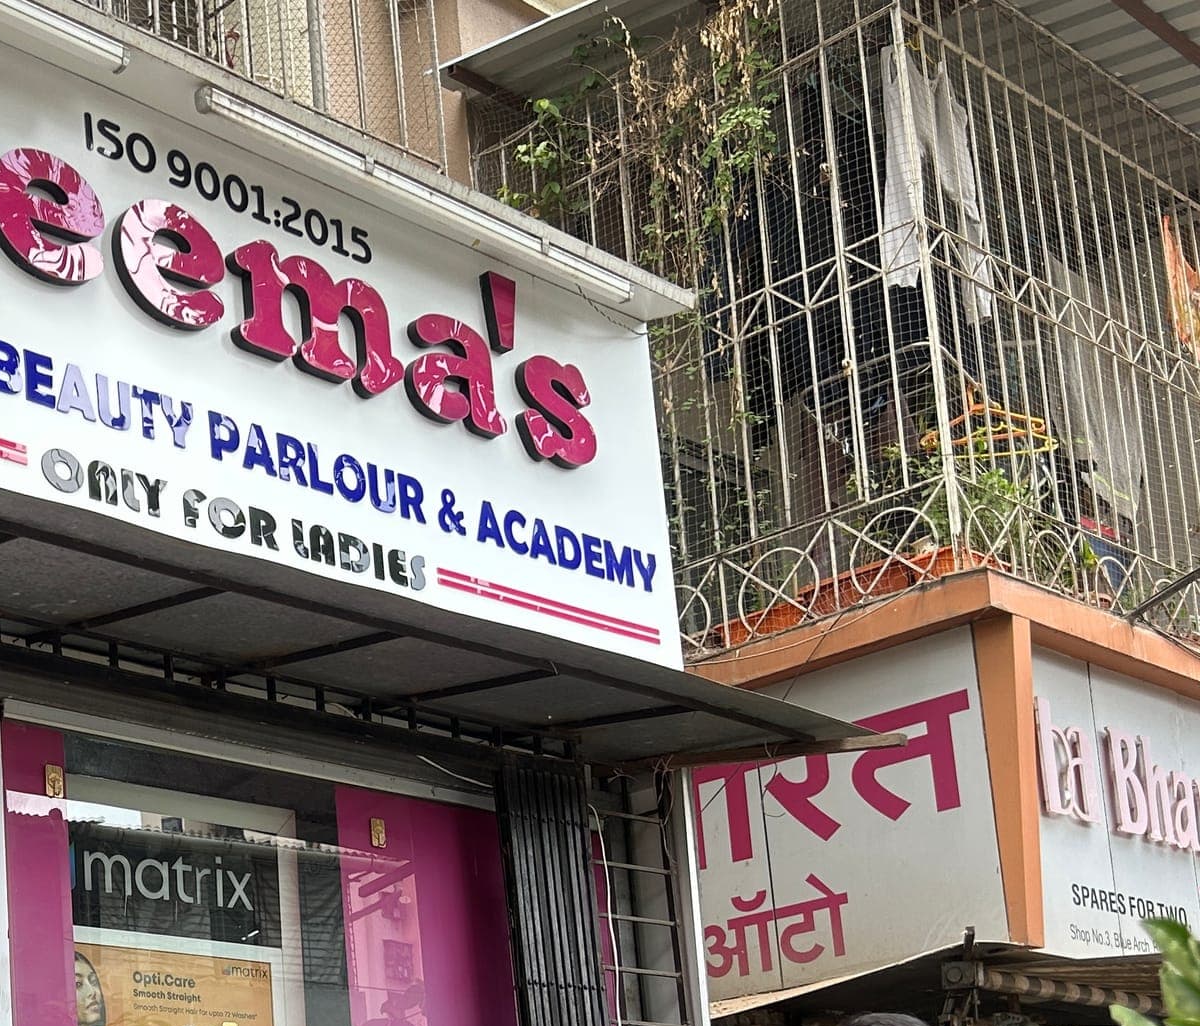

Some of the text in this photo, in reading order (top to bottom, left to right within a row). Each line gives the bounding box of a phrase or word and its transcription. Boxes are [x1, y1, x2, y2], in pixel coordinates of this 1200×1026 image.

[84, 112, 373, 265] ISO 9001:2015
[40, 448, 427, 591] ONLY FOR LADIES
[209, 411, 427, 525] PARLOUR
[437, 488, 467, 537] &
[476, 500, 657, 593] ACADEMY
[1103, 727, 1200, 852] Bha
[83, 850, 255, 912] matrix
[1071, 883, 1126, 916] SPARES
[1128, 896, 1156, 920] FOR
[703, 873, 850, 979] ऑटो
[1069, 923, 1091, 946] Shop
[132, 970, 196, 989] Opti.Care
[133, 988, 202, 1004] Smooth Straight
[231, 965, 269, 980] matrix
[133, 1002, 158, 1012] Smooth
[159, 1004, 184, 1015] Straight
